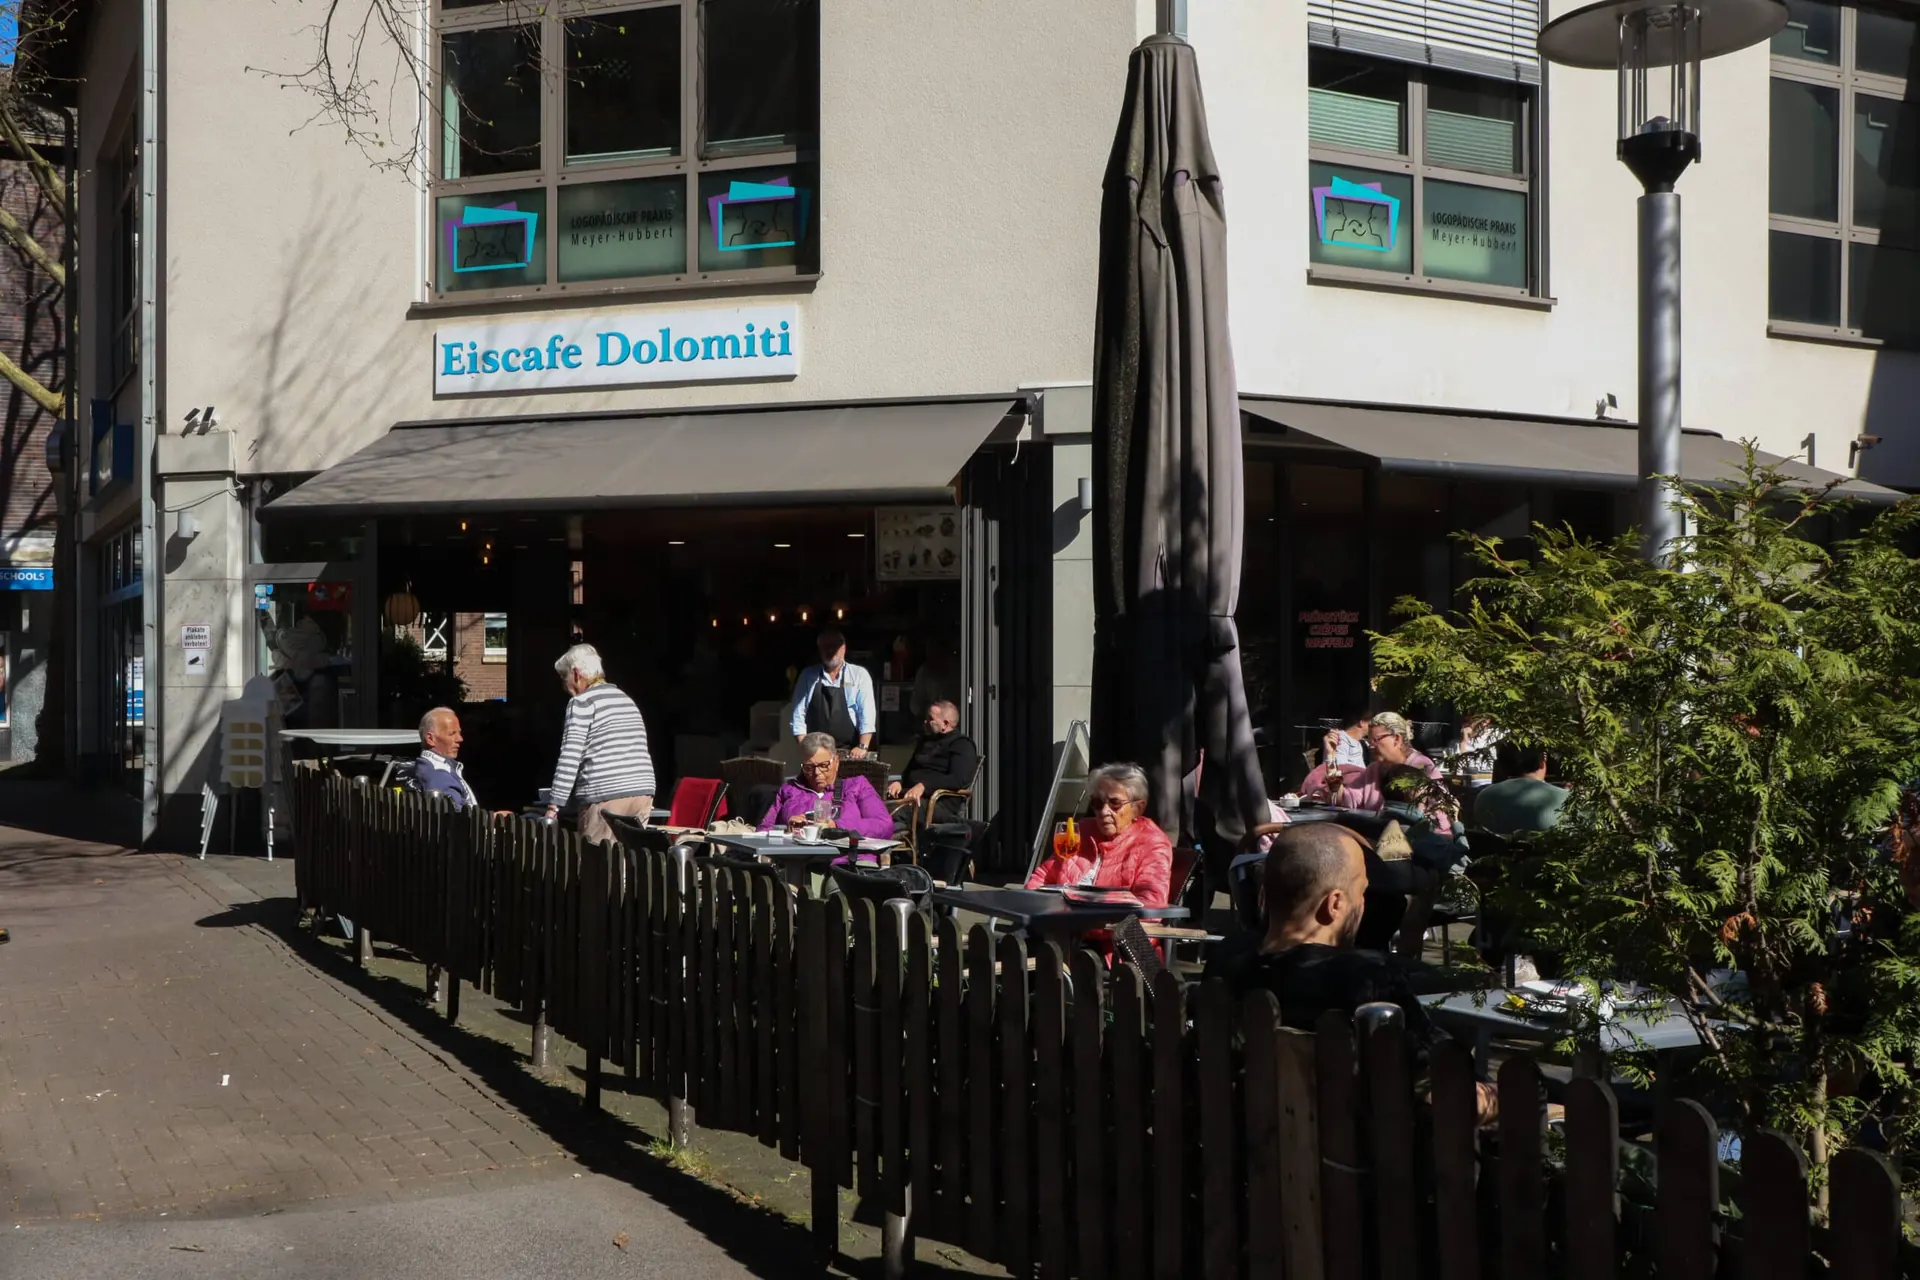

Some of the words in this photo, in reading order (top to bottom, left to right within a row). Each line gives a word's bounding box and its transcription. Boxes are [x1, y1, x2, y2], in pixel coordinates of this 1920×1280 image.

[641, 208, 673, 224] PRAXIS
[1432, 211, 1489, 231] LOGOPÄDISCHE
[1490, 220, 1517, 235] PRAXIS
[571, 225, 673, 248] Meyer-Hubbert
[1432, 228, 1517, 252] Meyer-Hubbert
[440, 334, 582, 377] Eiscafe
[596, 320, 793, 367] Dolomiti
